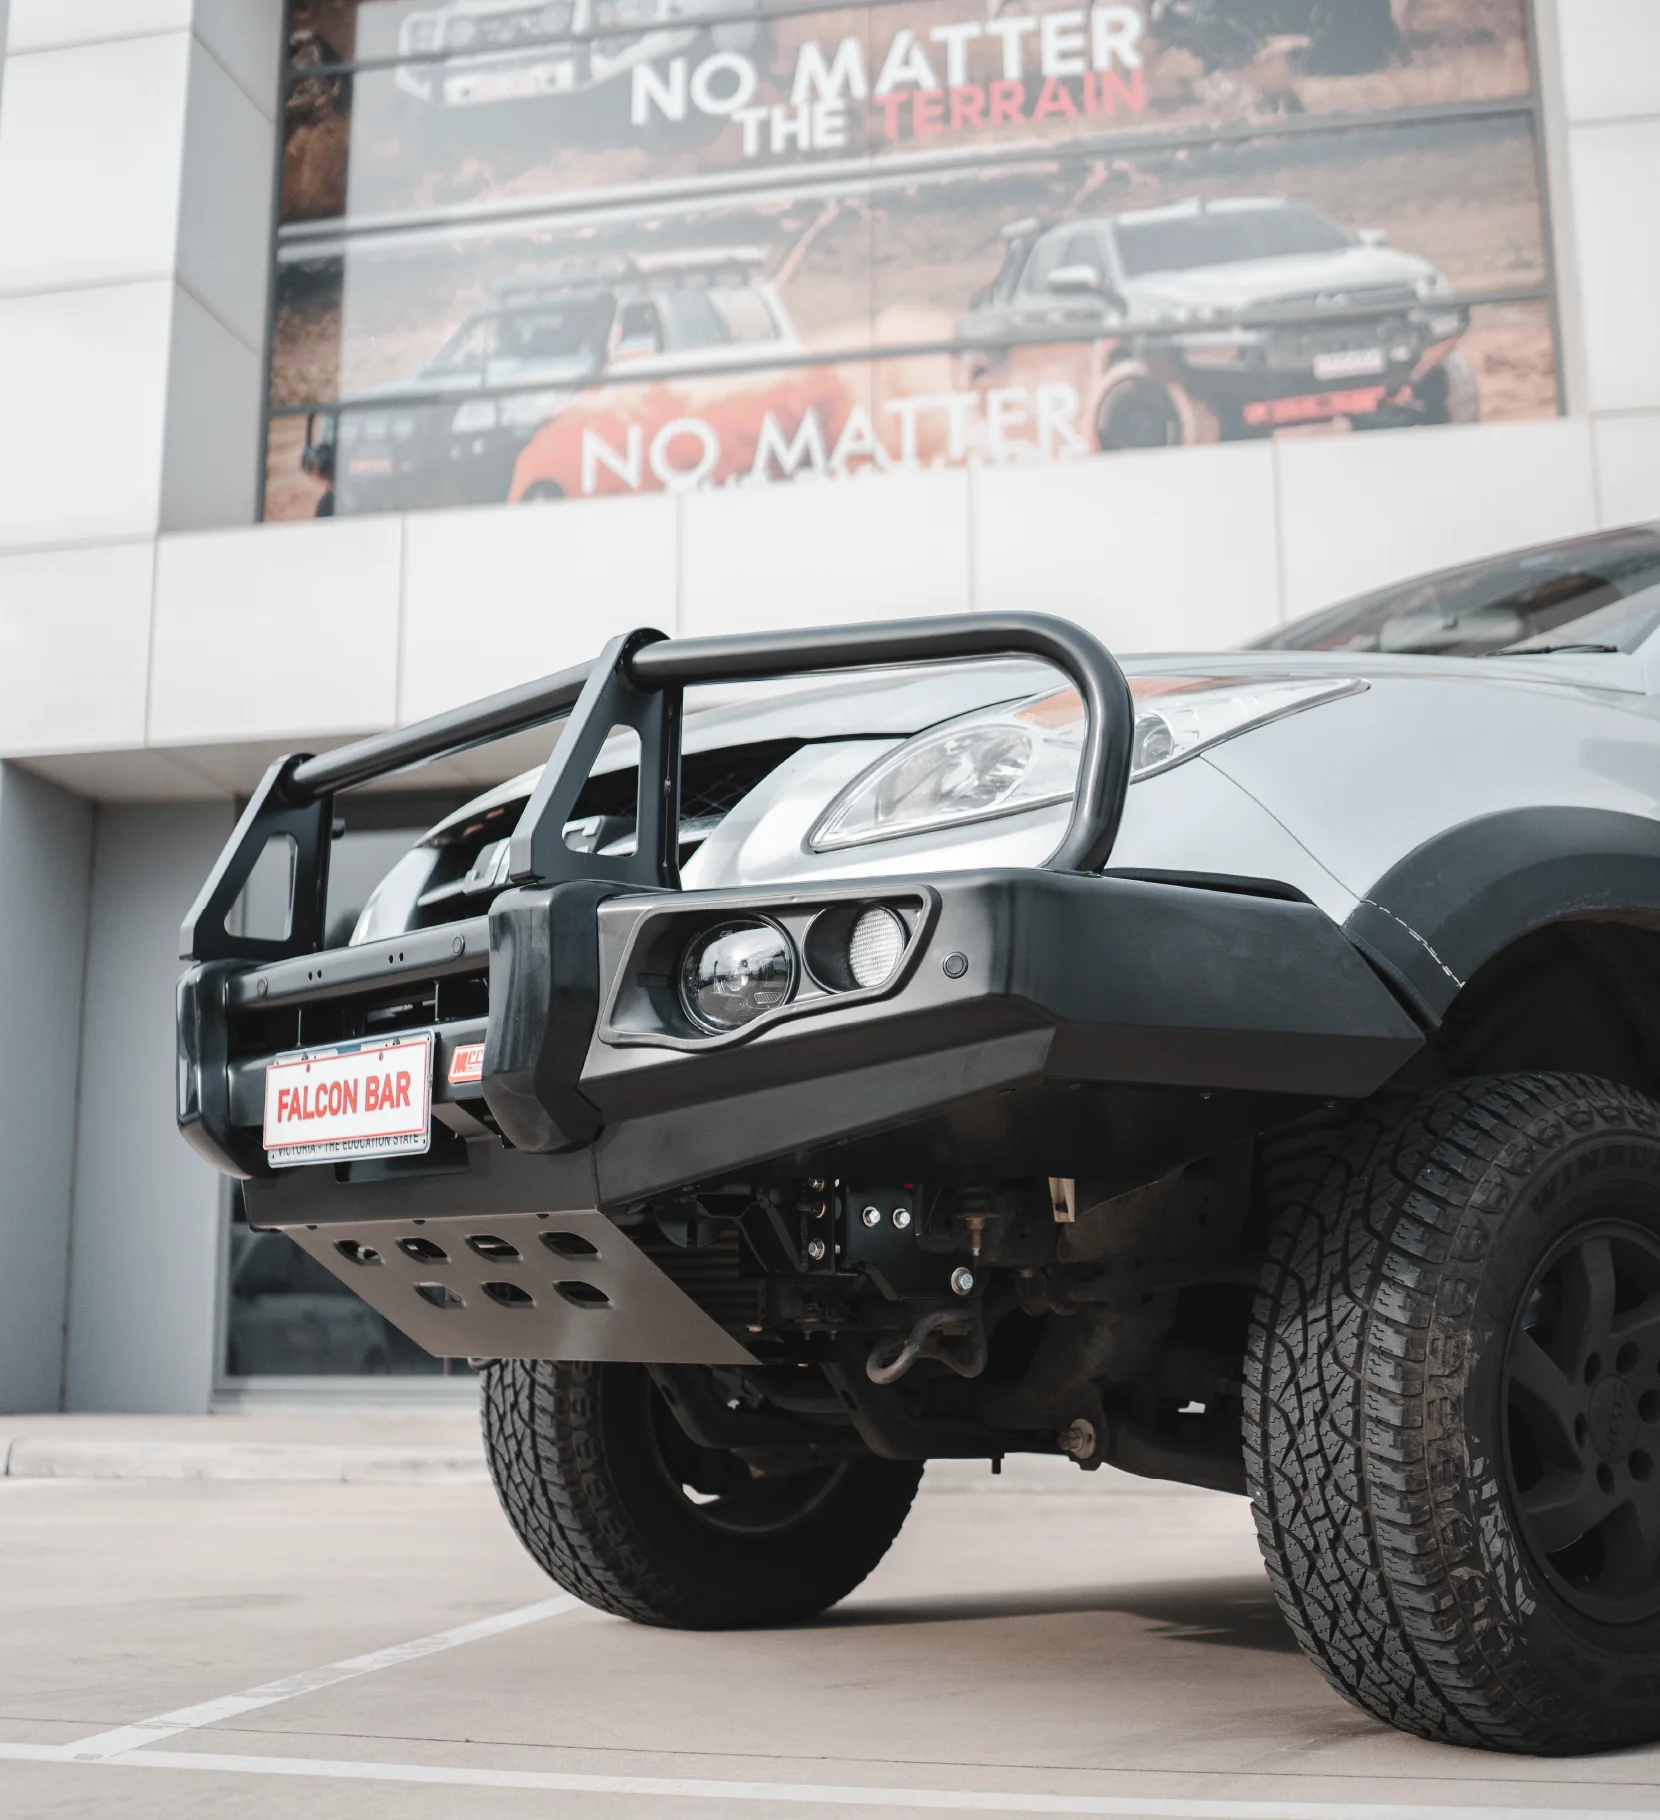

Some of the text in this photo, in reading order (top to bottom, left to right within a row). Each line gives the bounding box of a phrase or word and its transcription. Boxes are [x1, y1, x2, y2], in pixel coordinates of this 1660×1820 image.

[630, 3, 1145, 126] NO MATTER
[733, 67, 1146, 157] THE TERRAIN
[582, 417, 721, 493] NO
[752, 381, 1088, 482] MATTER
[277, 1070, 411, 1124] FALCON BAR
[278, 1144, 316, 1157] VICTORIA
[324, 1141, 340, 1153] THE
[342, 1136, 391, 1151] EDUCATION
[393, 1133, 419, 1146] STATE
